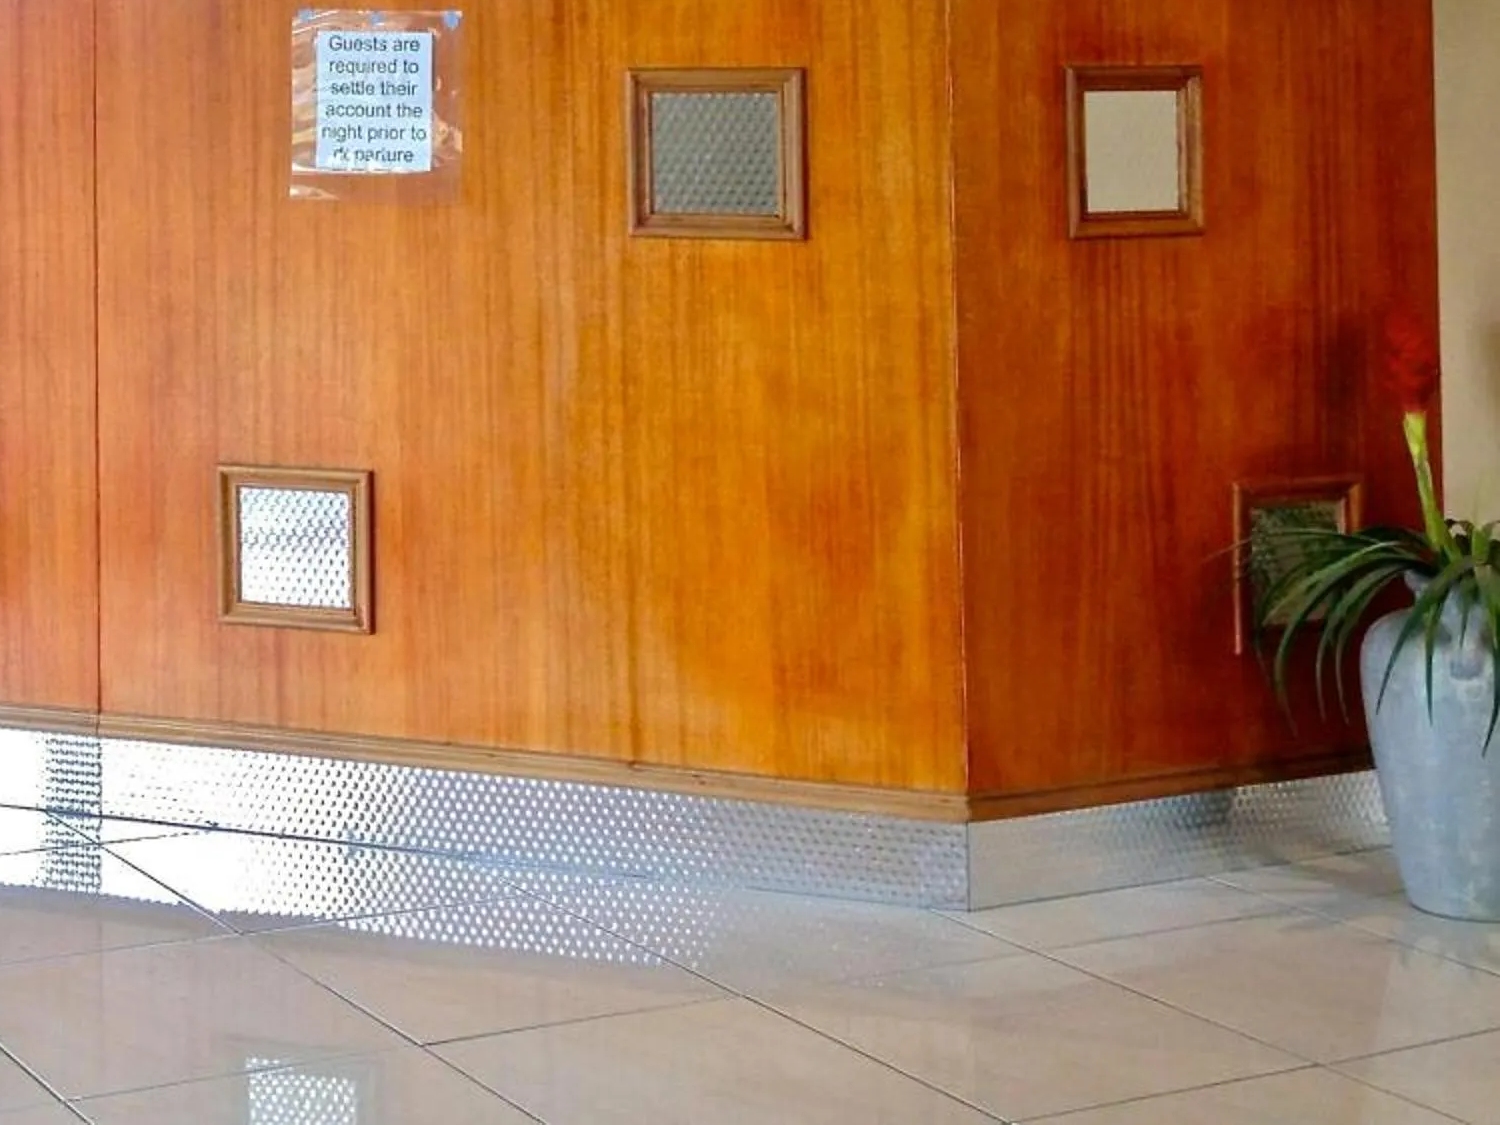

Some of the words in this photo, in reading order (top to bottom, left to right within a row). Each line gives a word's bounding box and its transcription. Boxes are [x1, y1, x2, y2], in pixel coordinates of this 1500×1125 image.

[329, 35, 387, 52] Guests
[393, 38, 421, 52] are
[329, 59, 397, 76] required
[403, 59, 420, 75] to
[331, 81, 376, 96] settle
[380, 81, 418, 96] their
[325, 104, 392, 118] account
[397, 103, 424, 118] the
[321, 124, 363, 143] night
[367, 125, 406, 144] prior
[411, 125, 428, 142] to
